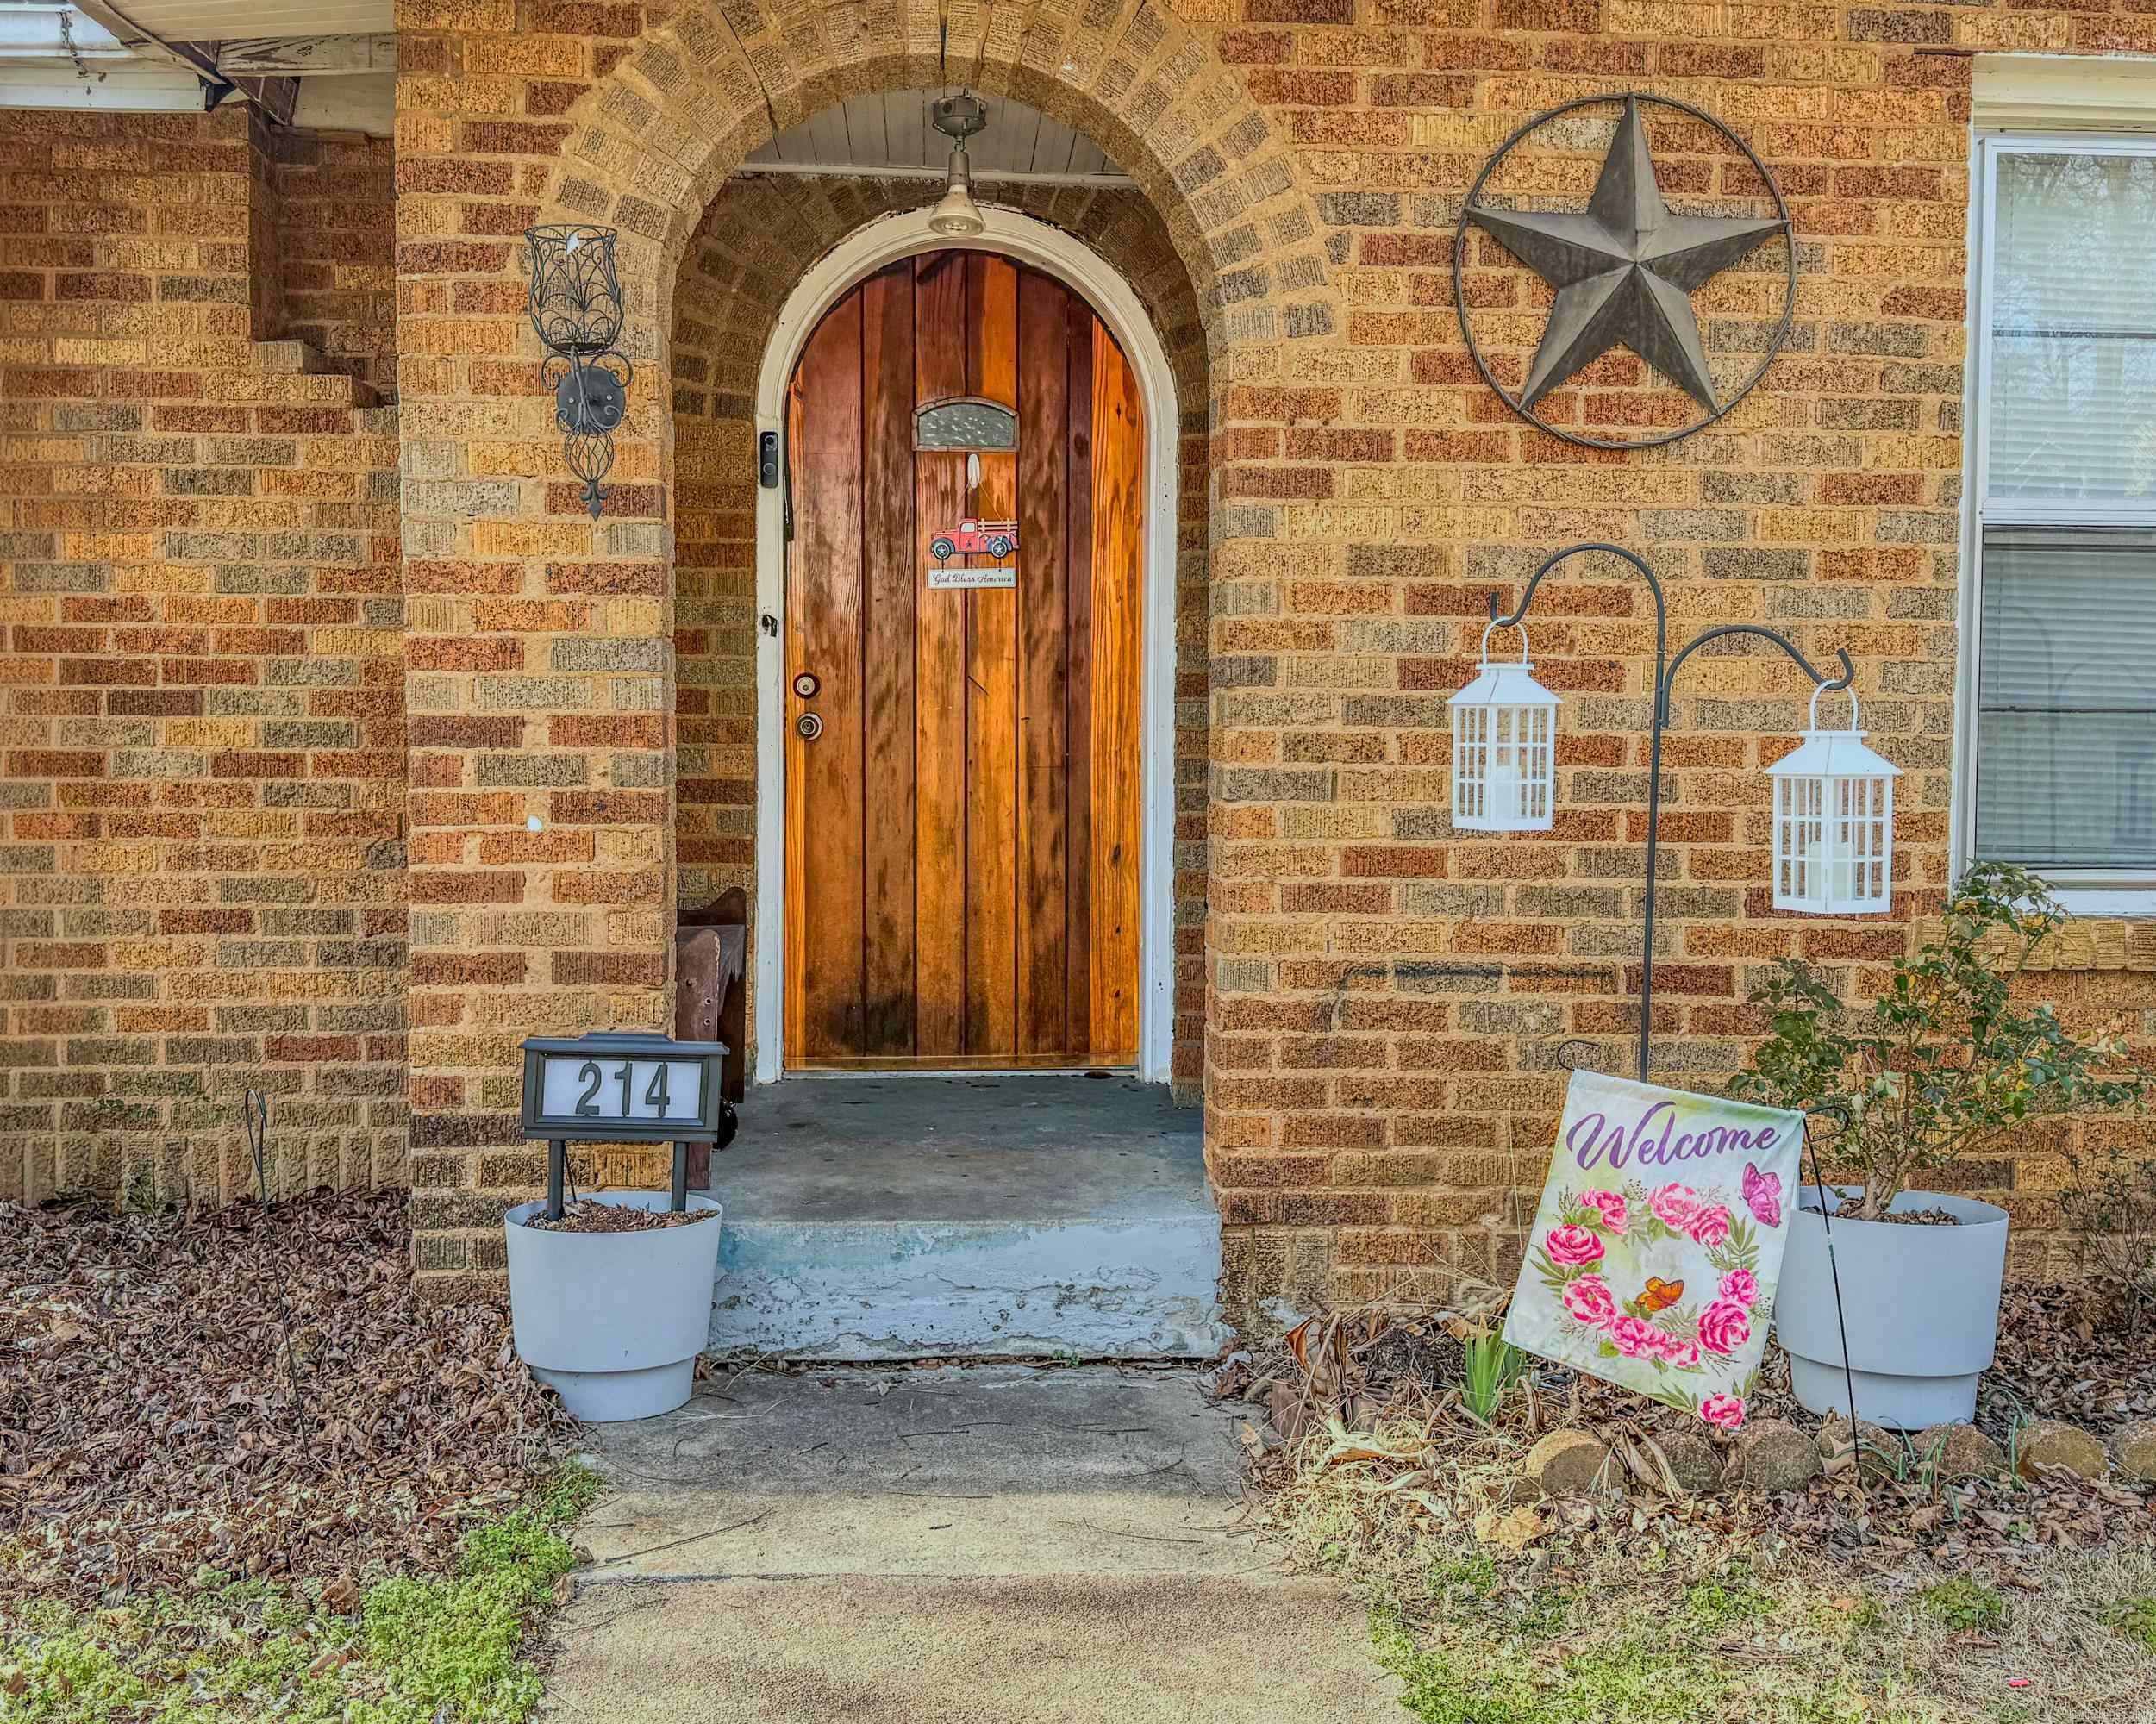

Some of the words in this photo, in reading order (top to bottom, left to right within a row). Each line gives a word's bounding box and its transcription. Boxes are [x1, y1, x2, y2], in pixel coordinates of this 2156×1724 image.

[932, 573, 950, 584] God
[952, 573, 975, 583] Bless
[977, 573, 1012, 583] America
[575, 1061, 671, 1118] 214
[1565, 1100, 1782, 1171] Welcome
